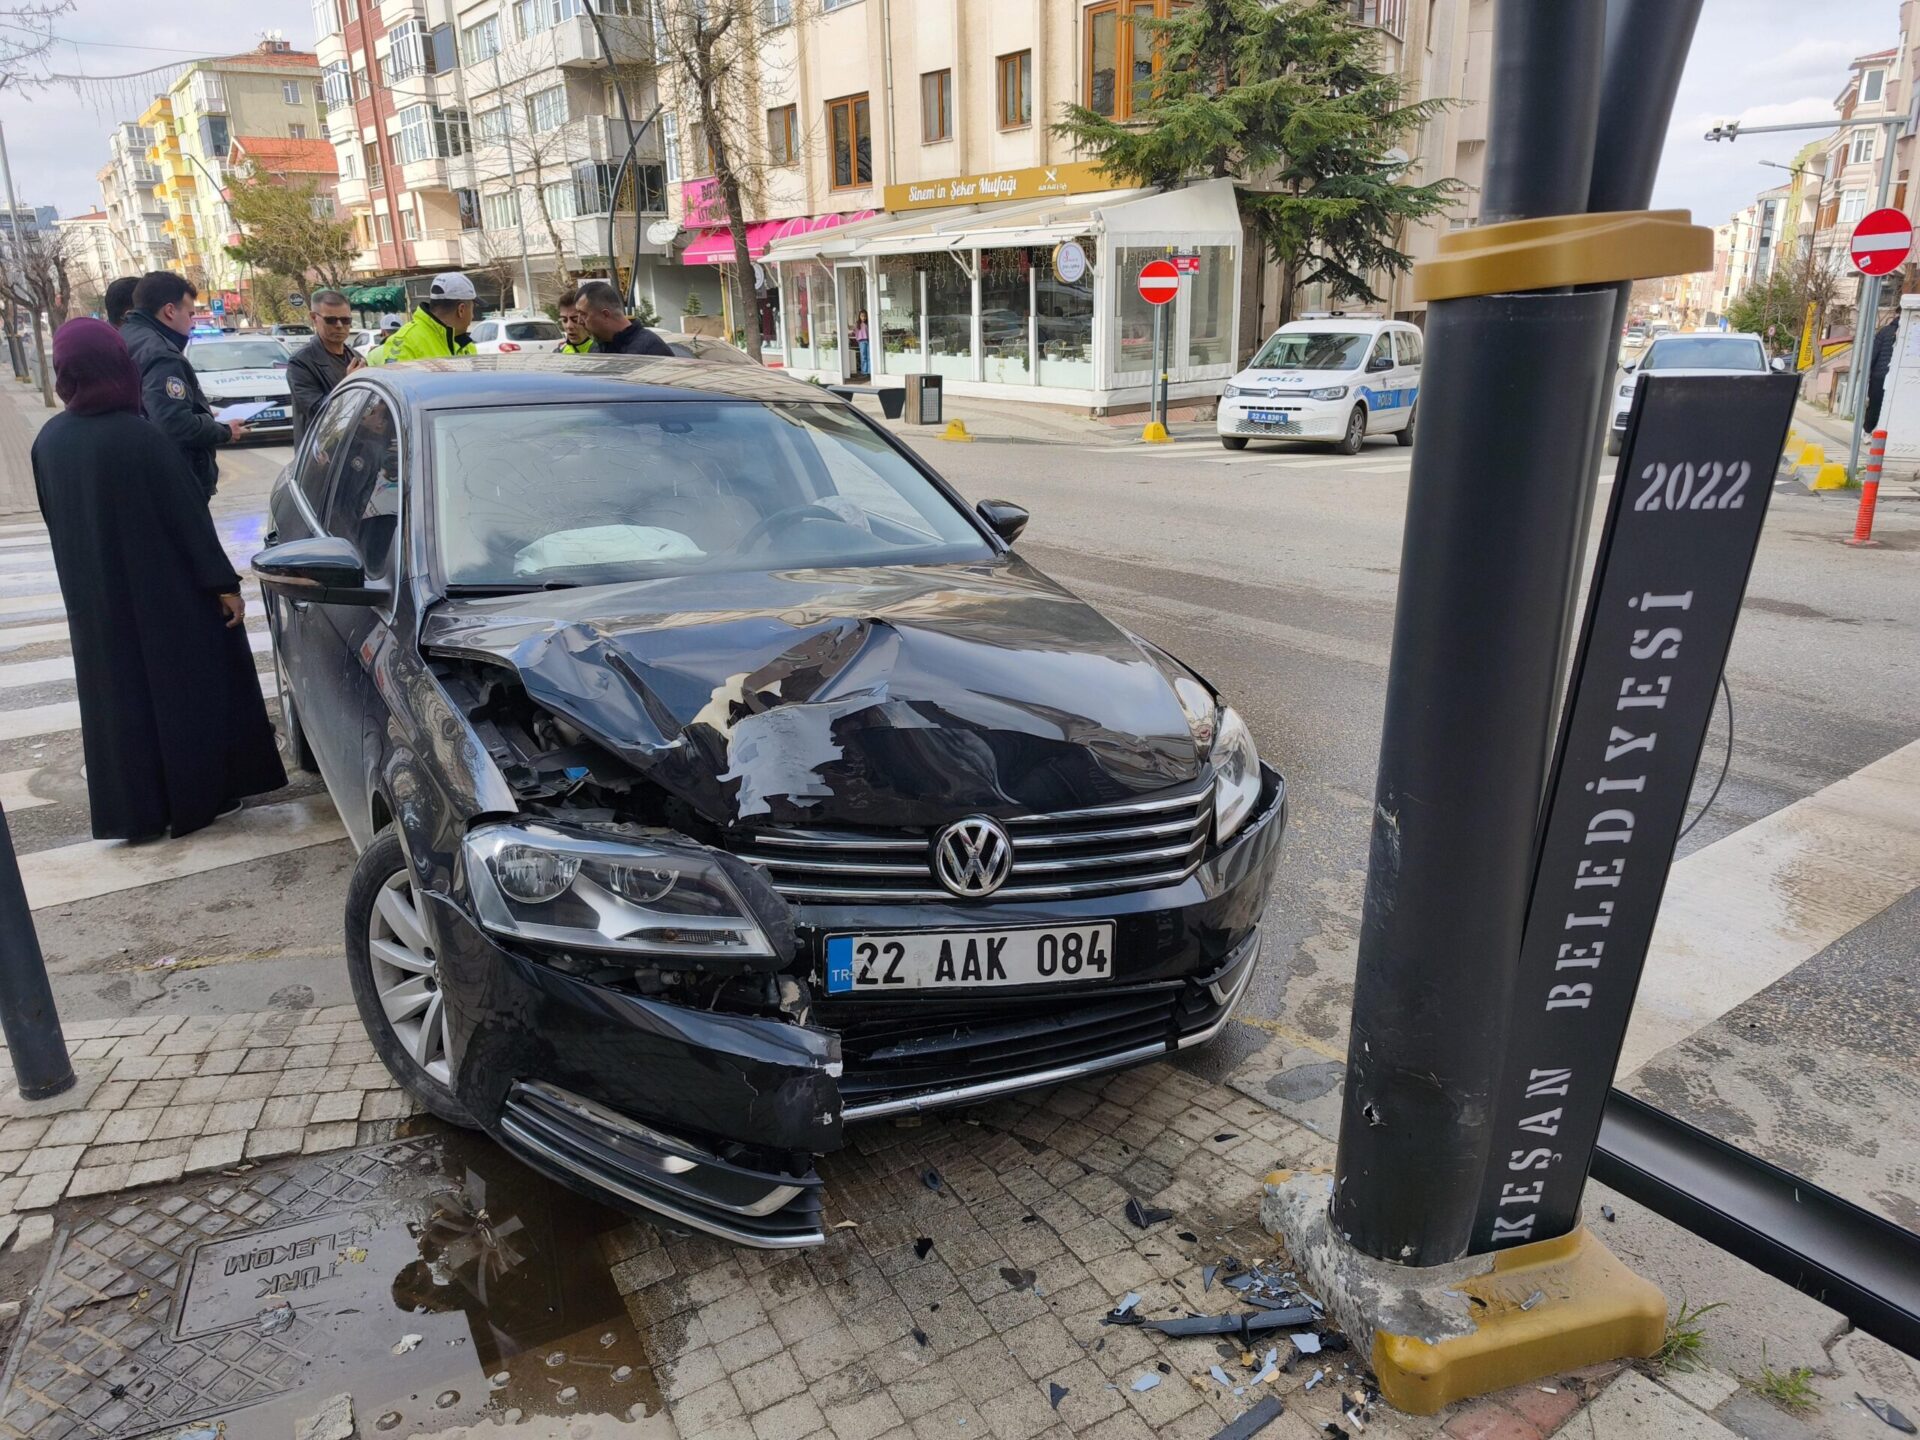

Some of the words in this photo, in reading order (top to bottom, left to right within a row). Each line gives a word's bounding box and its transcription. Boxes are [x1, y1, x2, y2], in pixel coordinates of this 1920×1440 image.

[908, 183, 946, 201] Sinem'in
[950, 180, 977, 200] Şeker
[978, 175, 1017, 197] Mutfağı
[1634, 460, 1752, 512] 2022
[1491, 1067, 1573, 1242] KEŞAN
[1545, 589, 1694, 1012] BELEDİYESİ
[831, 968, 851, 983] TR
[855, 941, 906, 986] 22
[934, 935, 1009, 982] AAK
[1036, 929, 1108, 977] 084
